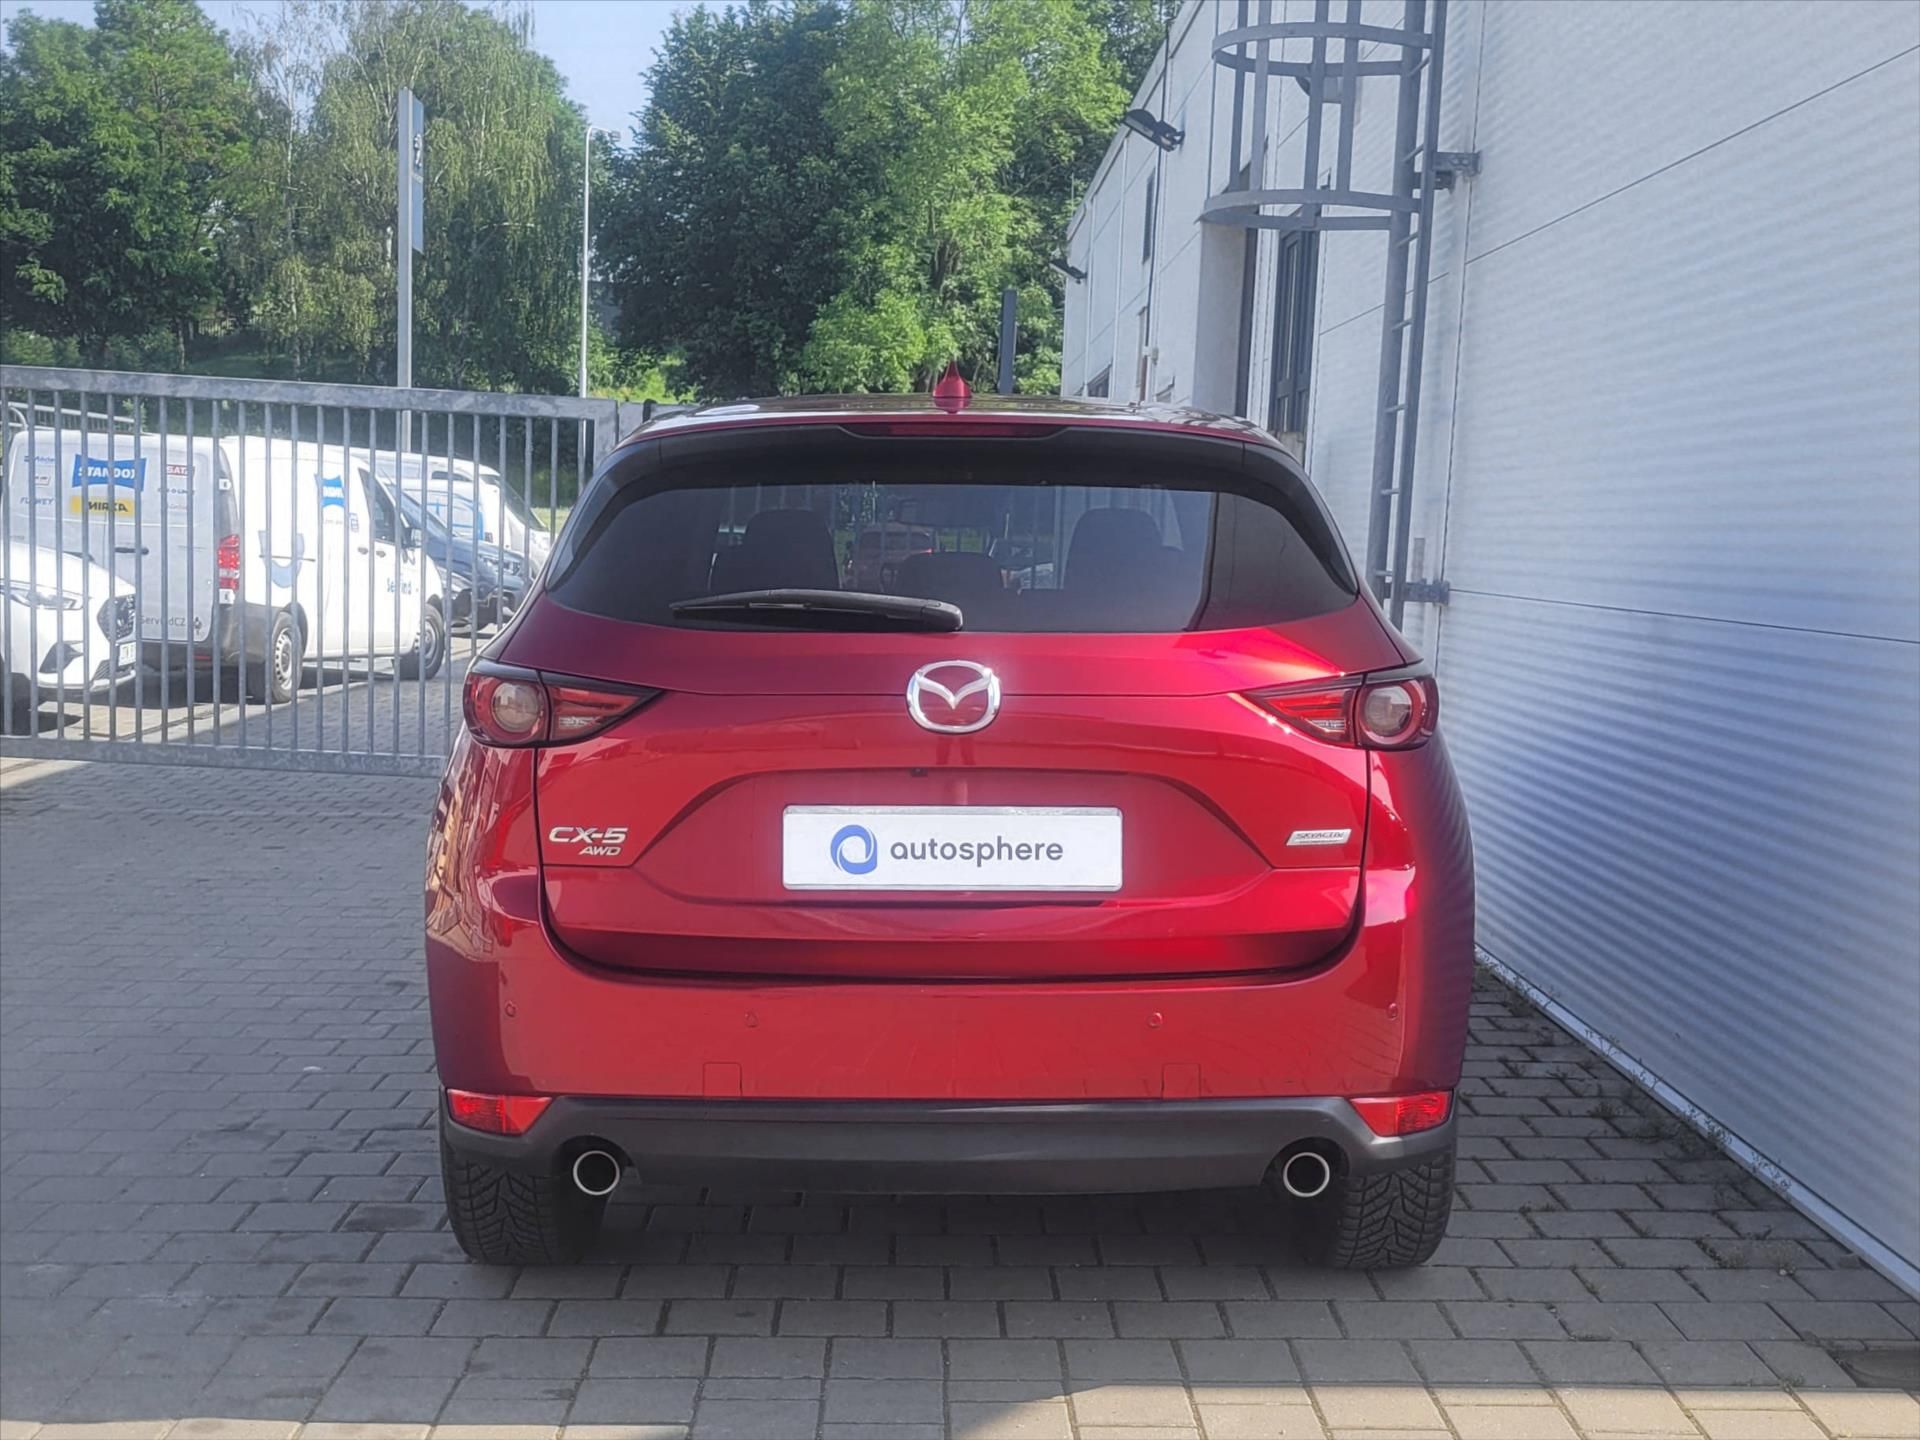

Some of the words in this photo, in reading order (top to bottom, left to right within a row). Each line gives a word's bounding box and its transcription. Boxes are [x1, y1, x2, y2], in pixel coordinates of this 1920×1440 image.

[549, 826, 628, 843] CX-5
[578, 846, 621, 856] AWD
[890, 835, 1063, 867] autosphere
